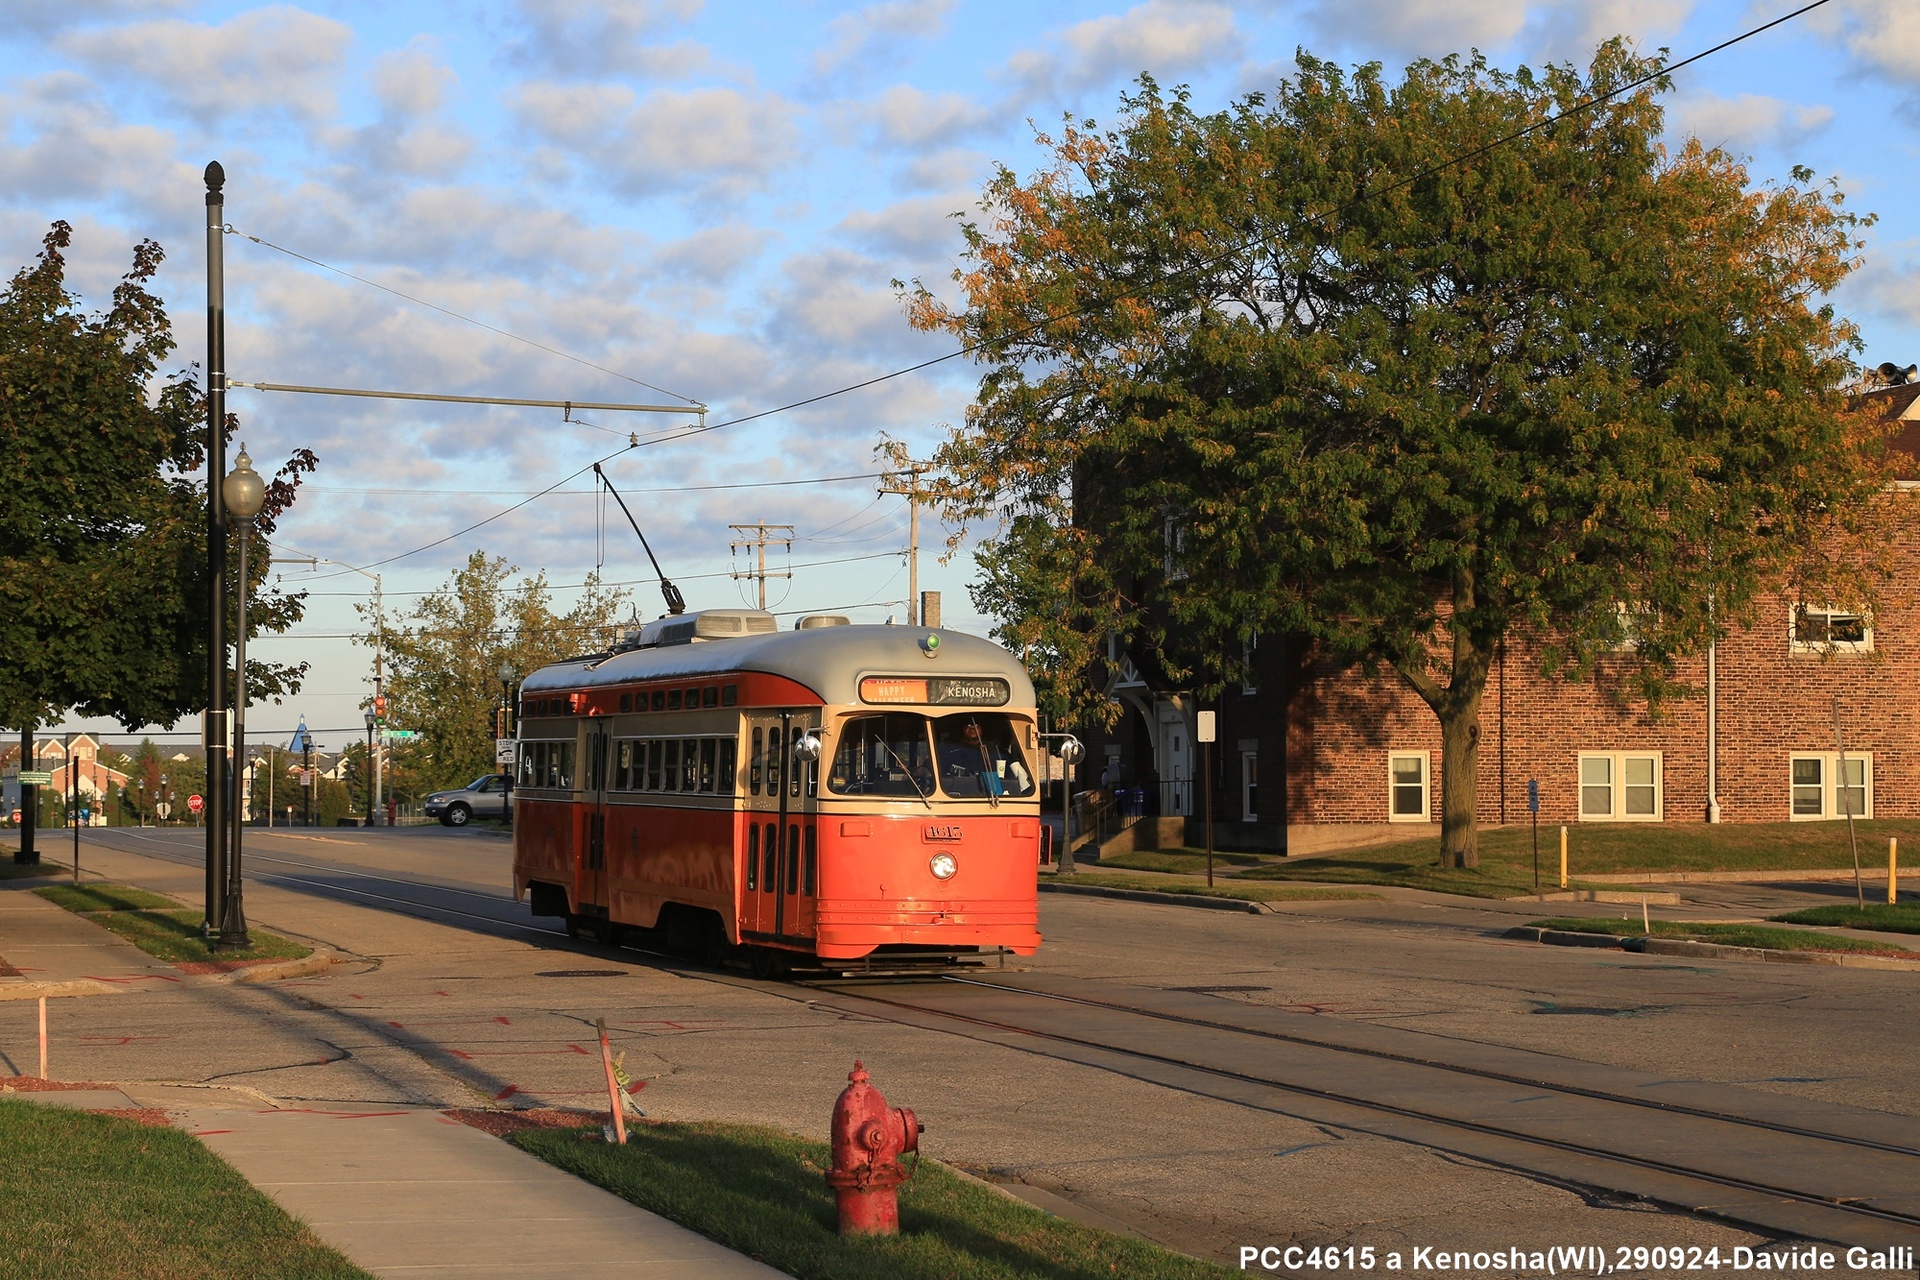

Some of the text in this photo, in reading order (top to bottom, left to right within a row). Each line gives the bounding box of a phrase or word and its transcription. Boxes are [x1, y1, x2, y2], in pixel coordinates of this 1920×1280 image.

[878, 686, 905, 696] HAPPY
[948, 686, 996, 698] KENOSHA
[926, 826, 962, 837] 4615
